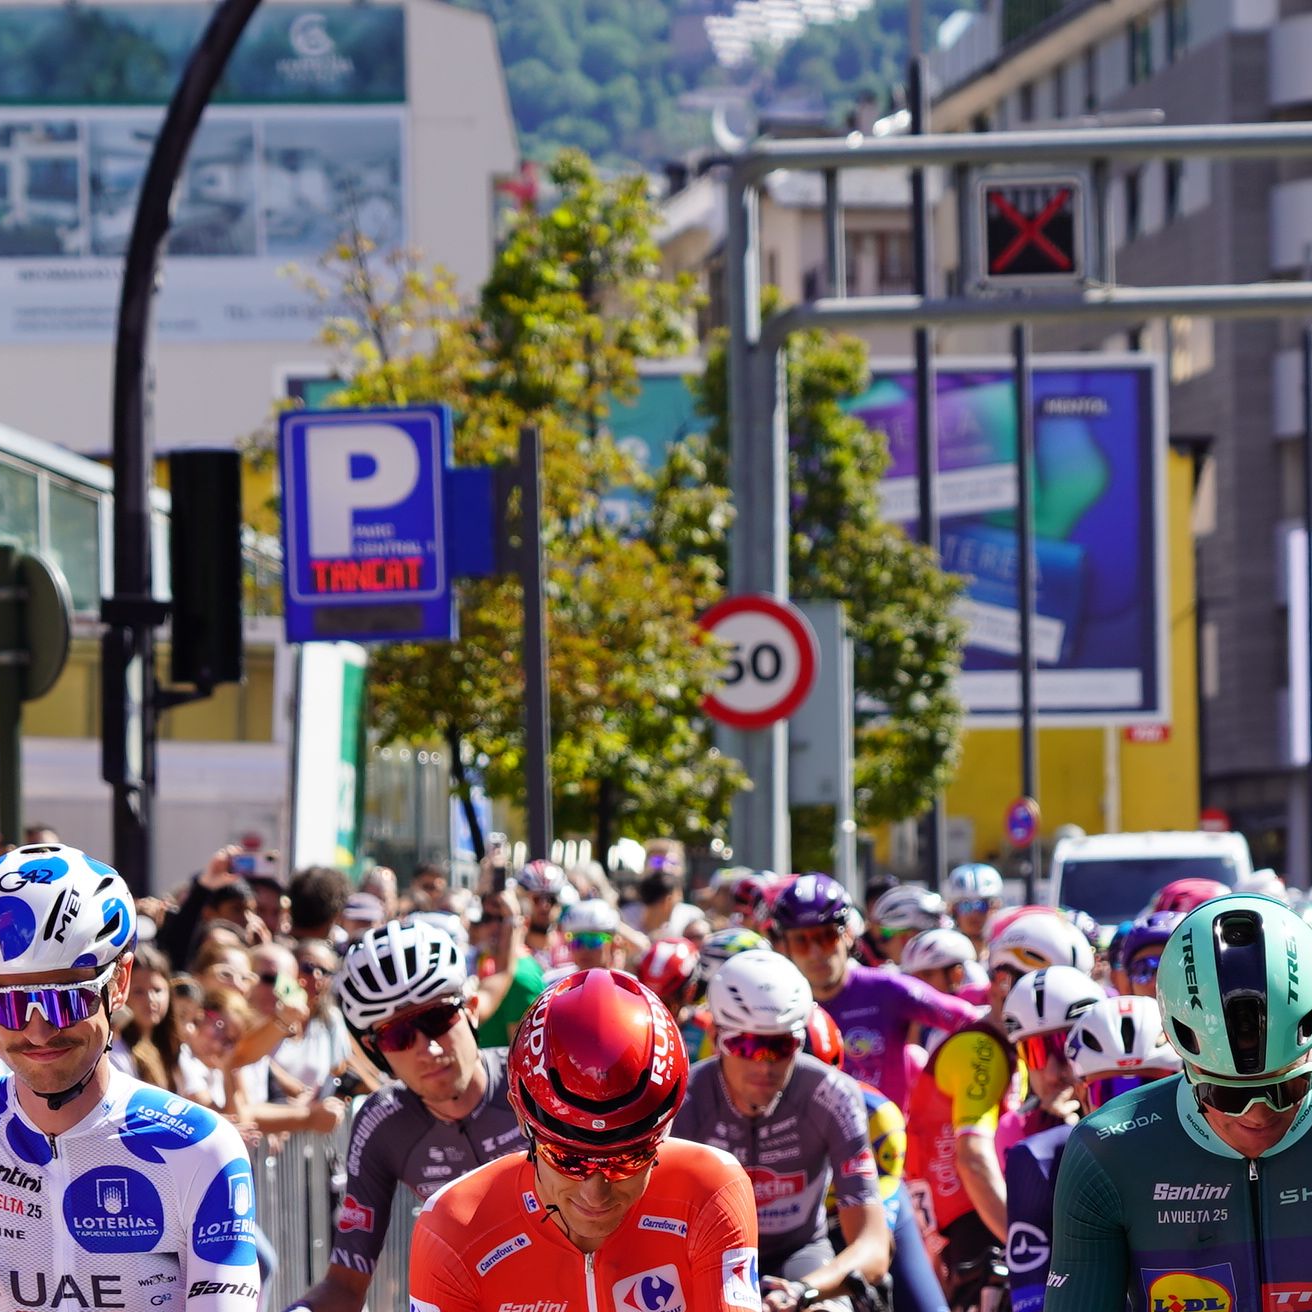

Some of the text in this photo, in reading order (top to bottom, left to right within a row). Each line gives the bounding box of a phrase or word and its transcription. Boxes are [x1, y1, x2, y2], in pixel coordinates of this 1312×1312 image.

[307, 423, 420, 558] P
[310, 557, 425, 593] TANCAT
[54, 885, 81, 944] MET
[1181, 927, 1204, 1011] TREK
[1152, 1183, 1232, 1201] Santini
[27, 1202, 42, 1219] 25
[73, 1214, 157, 1230] LOTERÍAS
[642, 1215, 678, 1232] Carrefour
[1158, 1208, 1229, 1224] LA VUELTA 25
[480, 1244, 515, 1273] Carrefour
[9, 1270, 126, 1309] UAE
